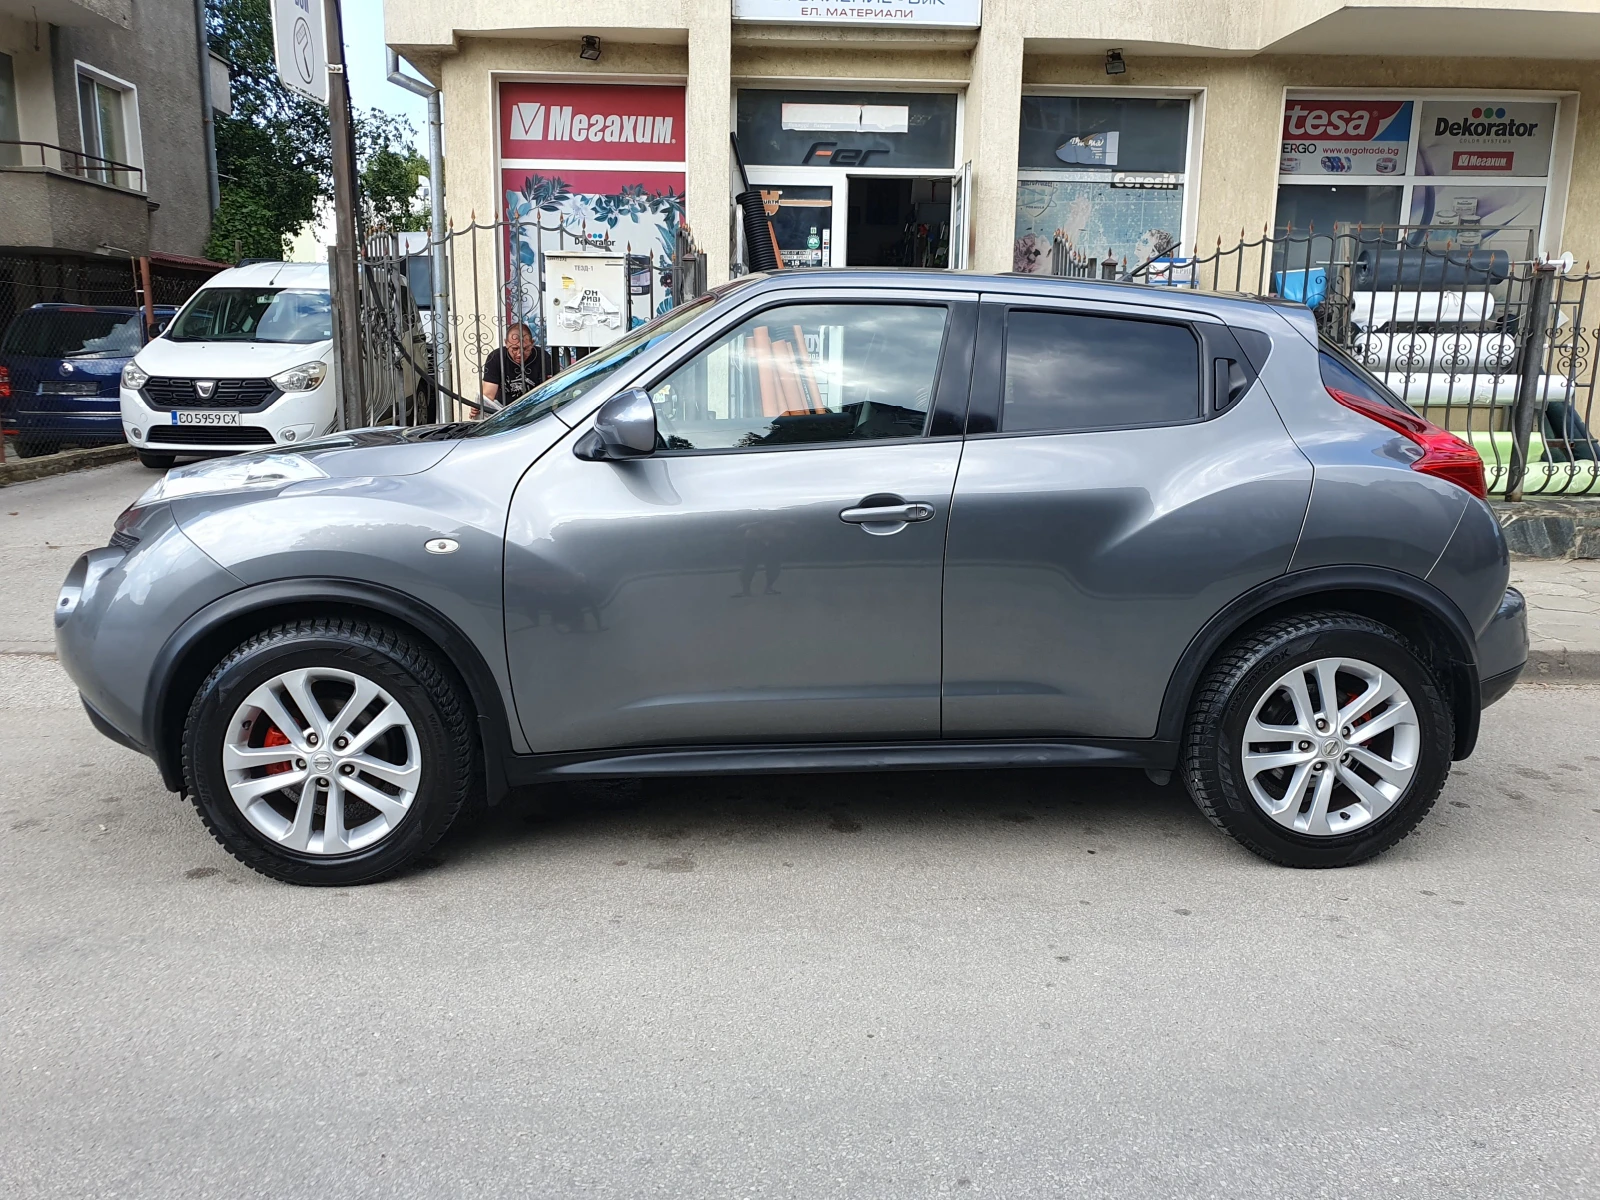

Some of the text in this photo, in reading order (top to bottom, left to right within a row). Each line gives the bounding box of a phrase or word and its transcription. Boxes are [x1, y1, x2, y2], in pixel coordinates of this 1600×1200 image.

[801, 7, 914, 19] ЕЛ. МАТЕРИАЛИ
[547, 105, 673, 145] Мегахим
[1284, 104, 1371, 137] tesa
[1434, 117, 1539, 138] Dekorator
[801, 141, 891, 167] Fer
[1282, 143, 1318, 154] ERGO
[1322, 146, 1400, 156] www.ergotrade.bg
[1468, 155, 1507, 167] Мегахим
[1113, 172, 1176, 189] Ceresit
[194, 413, 221, 425] 5959
